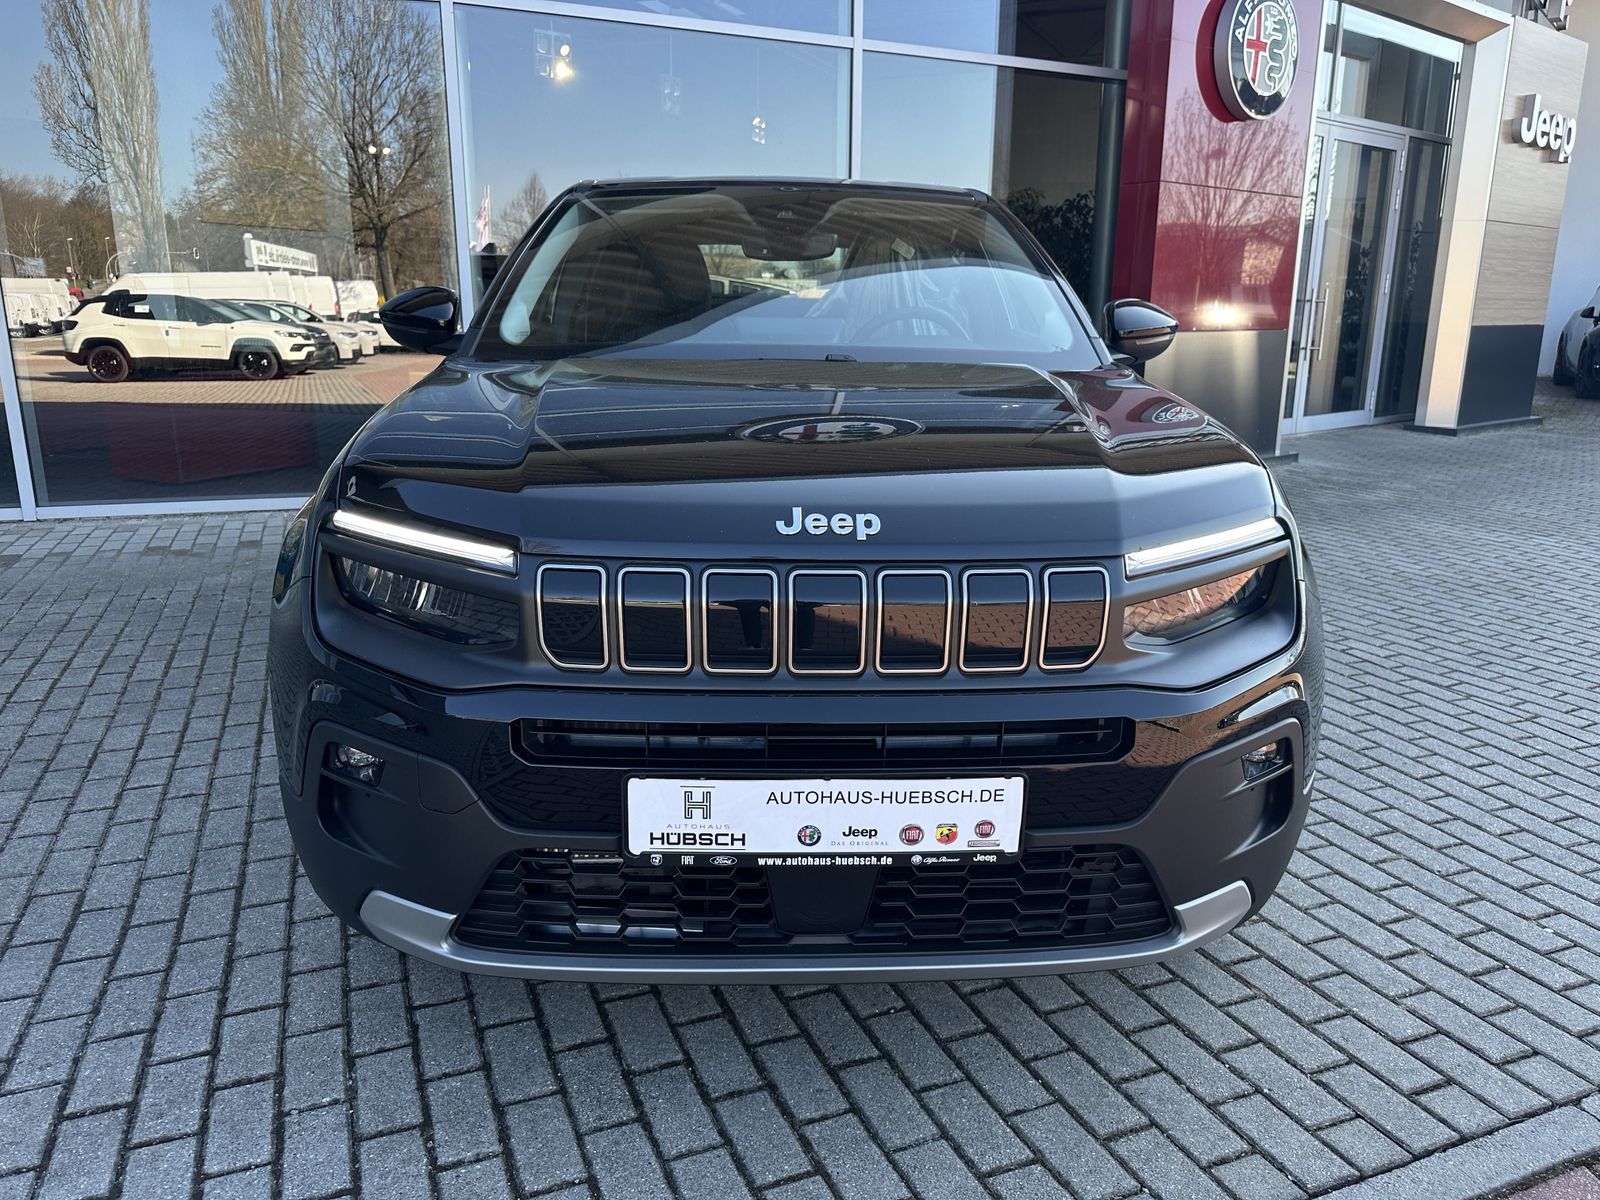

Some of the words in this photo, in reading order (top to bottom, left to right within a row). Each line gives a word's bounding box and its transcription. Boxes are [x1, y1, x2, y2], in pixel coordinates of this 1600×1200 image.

[1234, 0, 1258, 44] ALF
[1519, 93, 1577, 163] Jeep
[775, 507, 881, 540] Jeep
[766, 789, 1005, 804] AUTOHAUS-HUEBSCH.DE
[842, 826, 878, 839] Jeep
[905, 830, 920, 841] FIAT
[979, 824, 992, 834] FIAT
[649, 832, 746, 847] HÜBSCH
[681, 855, 695, 866] FIAT
[757, 855, 893, 866] www.autohaus-huebsch.de
[973, 854, 997, 863] Jeep
